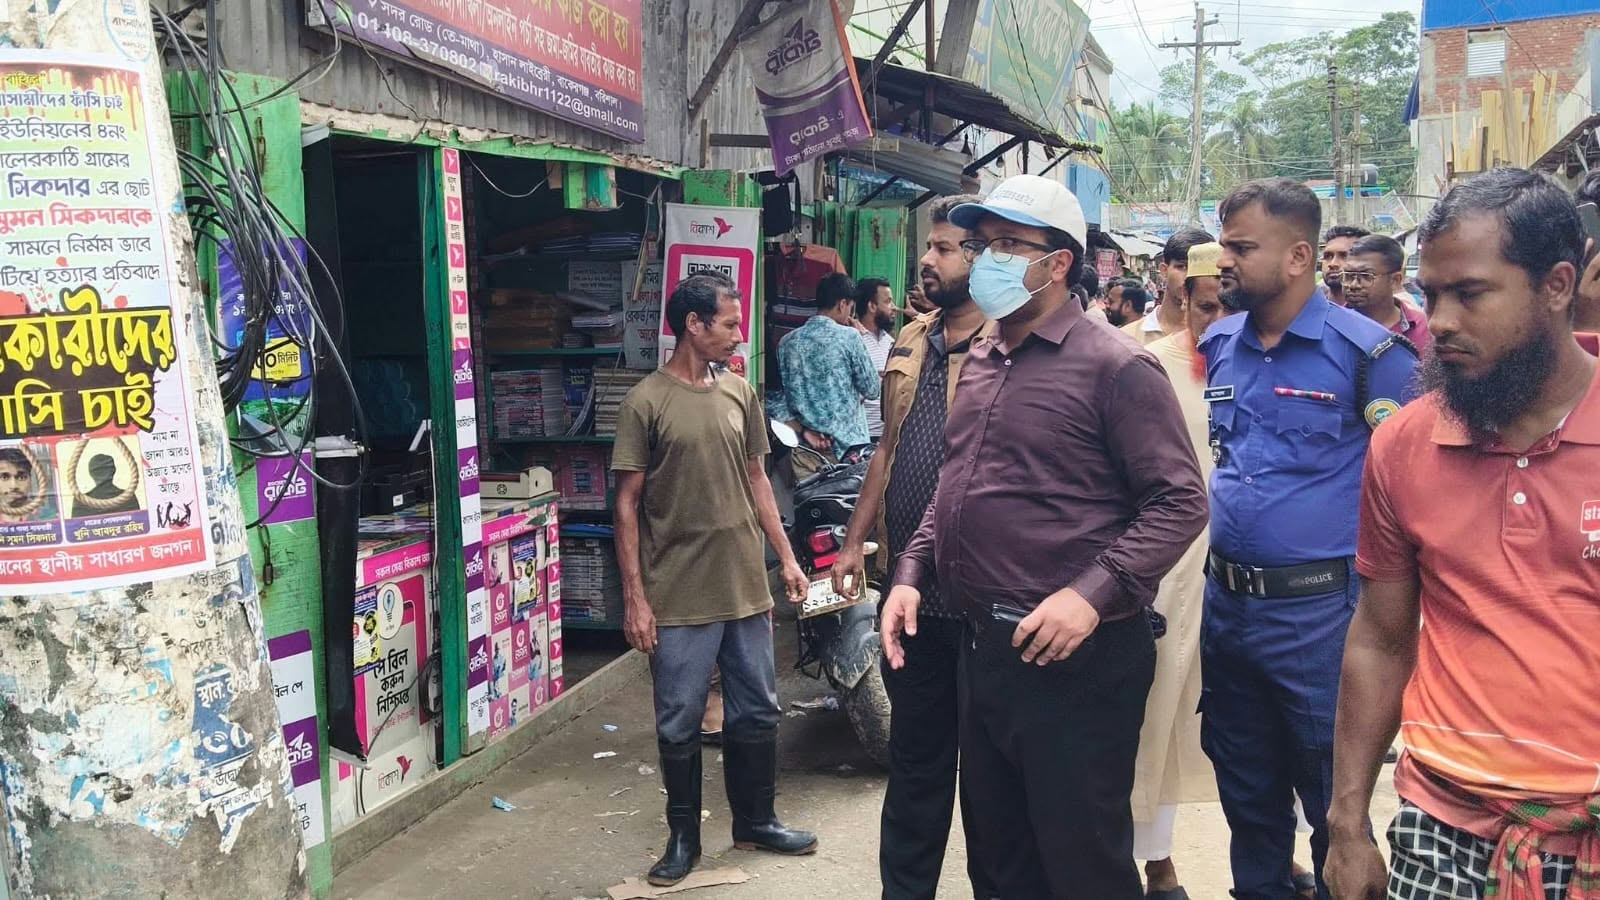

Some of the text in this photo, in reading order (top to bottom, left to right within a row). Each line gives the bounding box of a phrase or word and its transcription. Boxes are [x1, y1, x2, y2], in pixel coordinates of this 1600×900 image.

[380, 1, 406, 23] সদর
[408, 14, 434, 33] রোড
[0, 89, 124, 111] সামীদের ফাঁসি চাই
[83, 152, 130, 169] গ্রামের
[7, 171, 150, 199] সিকদার এর ছোট
[50, 201, 153, 227] সিকদারকে
[7, 232, 151, 257] সামনে নির্মম ভাবে
[44, 267, 97, 283] হত্যার
[102, 260, 161, 282] প্রতিবাদে
[78, 371, 153, 431] চাই
[36, 550, 84, 577] স্থানীয়
[88, 546, 145, 569] সাধারণ
[1304, 572, 1333, 585] POLICE
[388, 648, 409, 673] বিল
[380, 669, 405, 693] করুন
